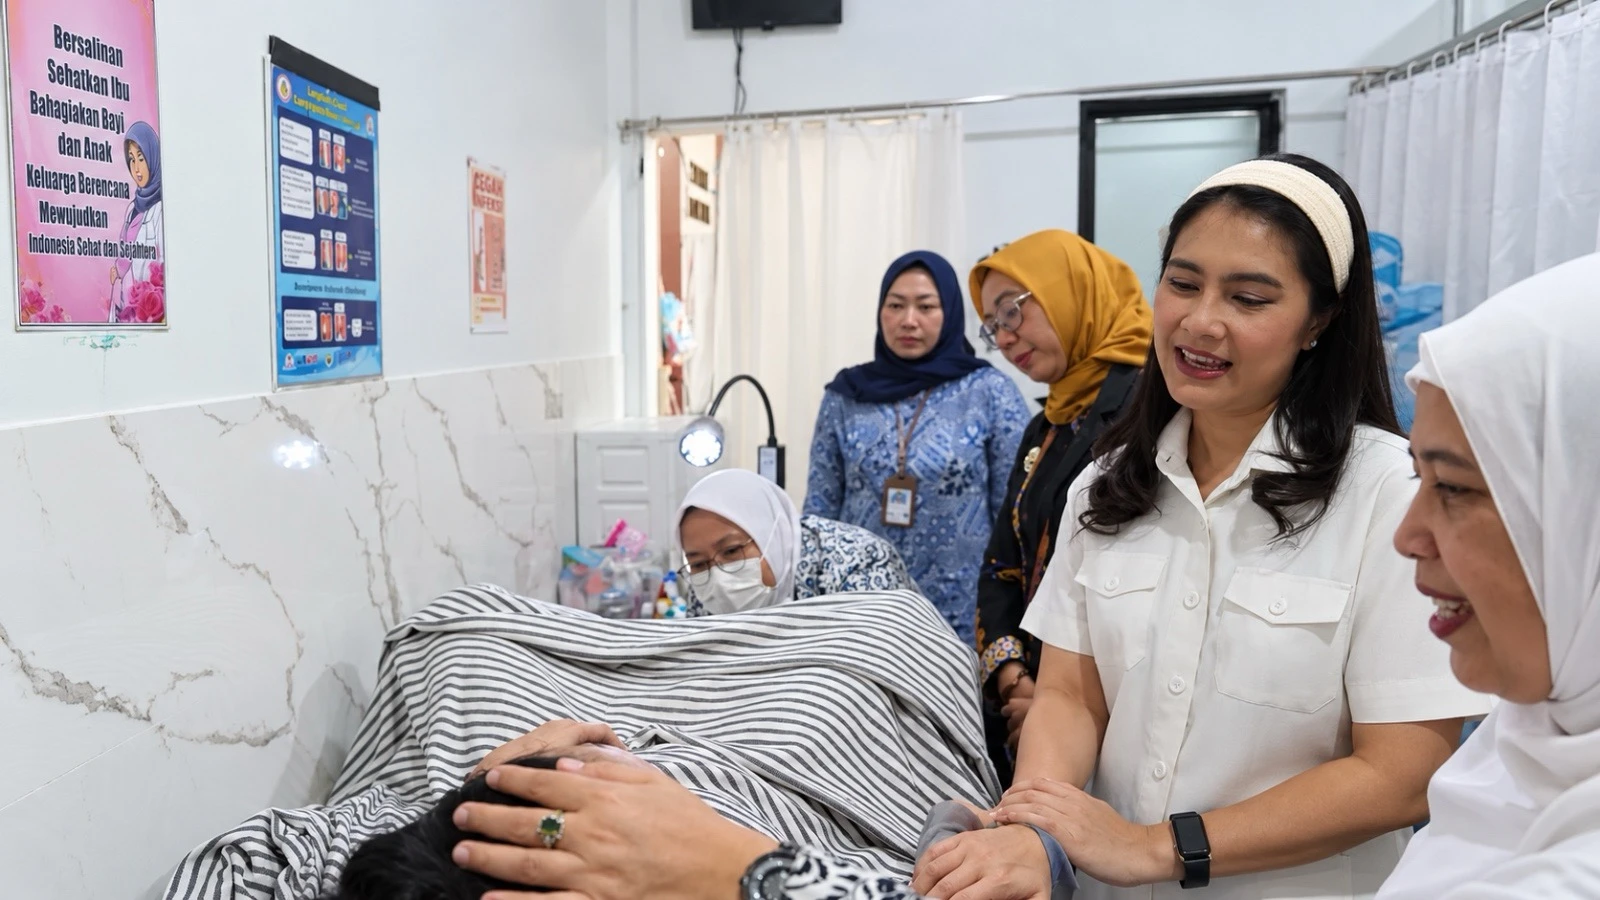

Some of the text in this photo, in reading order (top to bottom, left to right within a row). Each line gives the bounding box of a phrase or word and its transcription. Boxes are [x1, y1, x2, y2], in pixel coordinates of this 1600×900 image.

[53, 24, 123, 68] Bersalinan
[47, 58, 130, 102] Sehatkan Ibu
[30, 90, 125, 134] Bahagiakan Bayi
[58, 132, 112, 163] dan Anak
[26, 163, 130, 200] Keluarga Berencana
[39, 200, 108, 229] Mewujudkan
[29, 233, 156, 261] Indonesia Sehat dan Sejahtera
